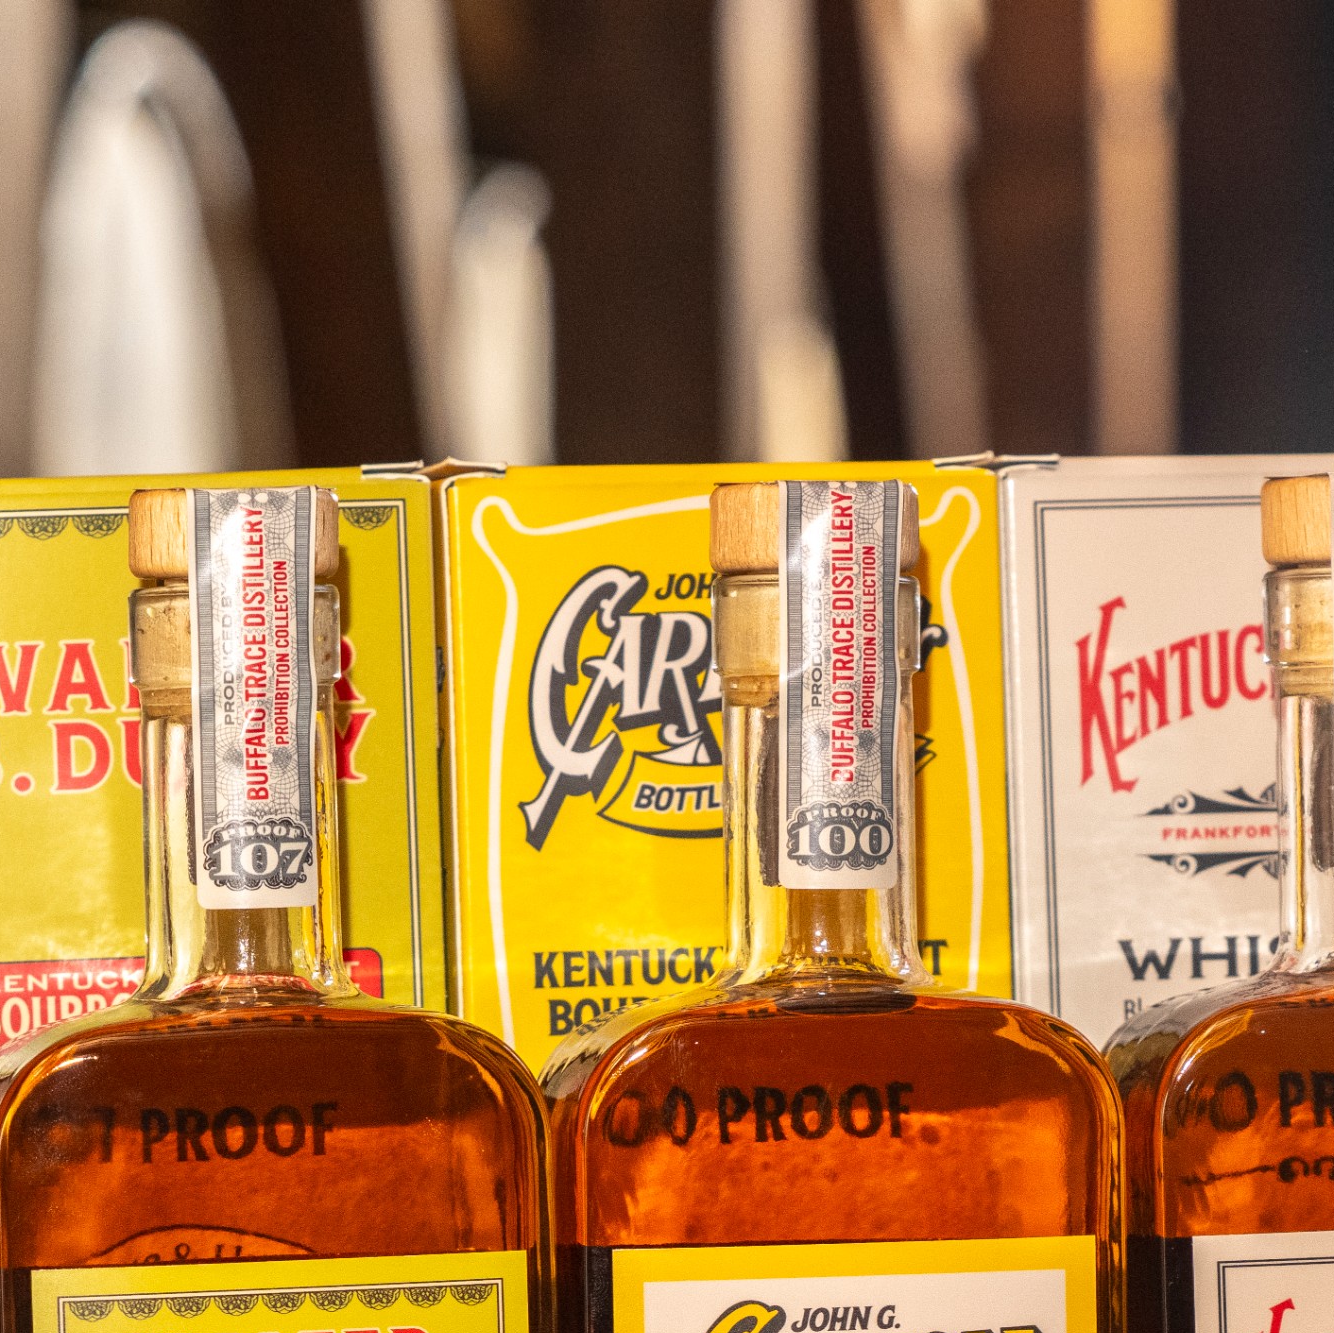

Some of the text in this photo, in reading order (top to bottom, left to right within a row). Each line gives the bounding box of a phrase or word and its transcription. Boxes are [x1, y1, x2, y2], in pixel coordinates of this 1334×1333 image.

[242, 506, 269, 800] BUFFALO TRACE DISTILLERY
[274, 560, 289, 745] PROHIBITION COLLECTION
[831, 490, 854, 782] BUFFALO TRACE DISTILLERY
[862, 546, 875, 729] PROHIBITION COLLECTION
[221, 822, 303, 841] PROOF
[790, 824, 892, 858] 100
[803, 807, 882, 822] PROOF
[211, 841, 312, 878] 107
[140, 1101, 338, 1164] PROOF
[717, 1081, 914, 1144] PROOF
[792, 1305, 901, 1332] JOHN G.
